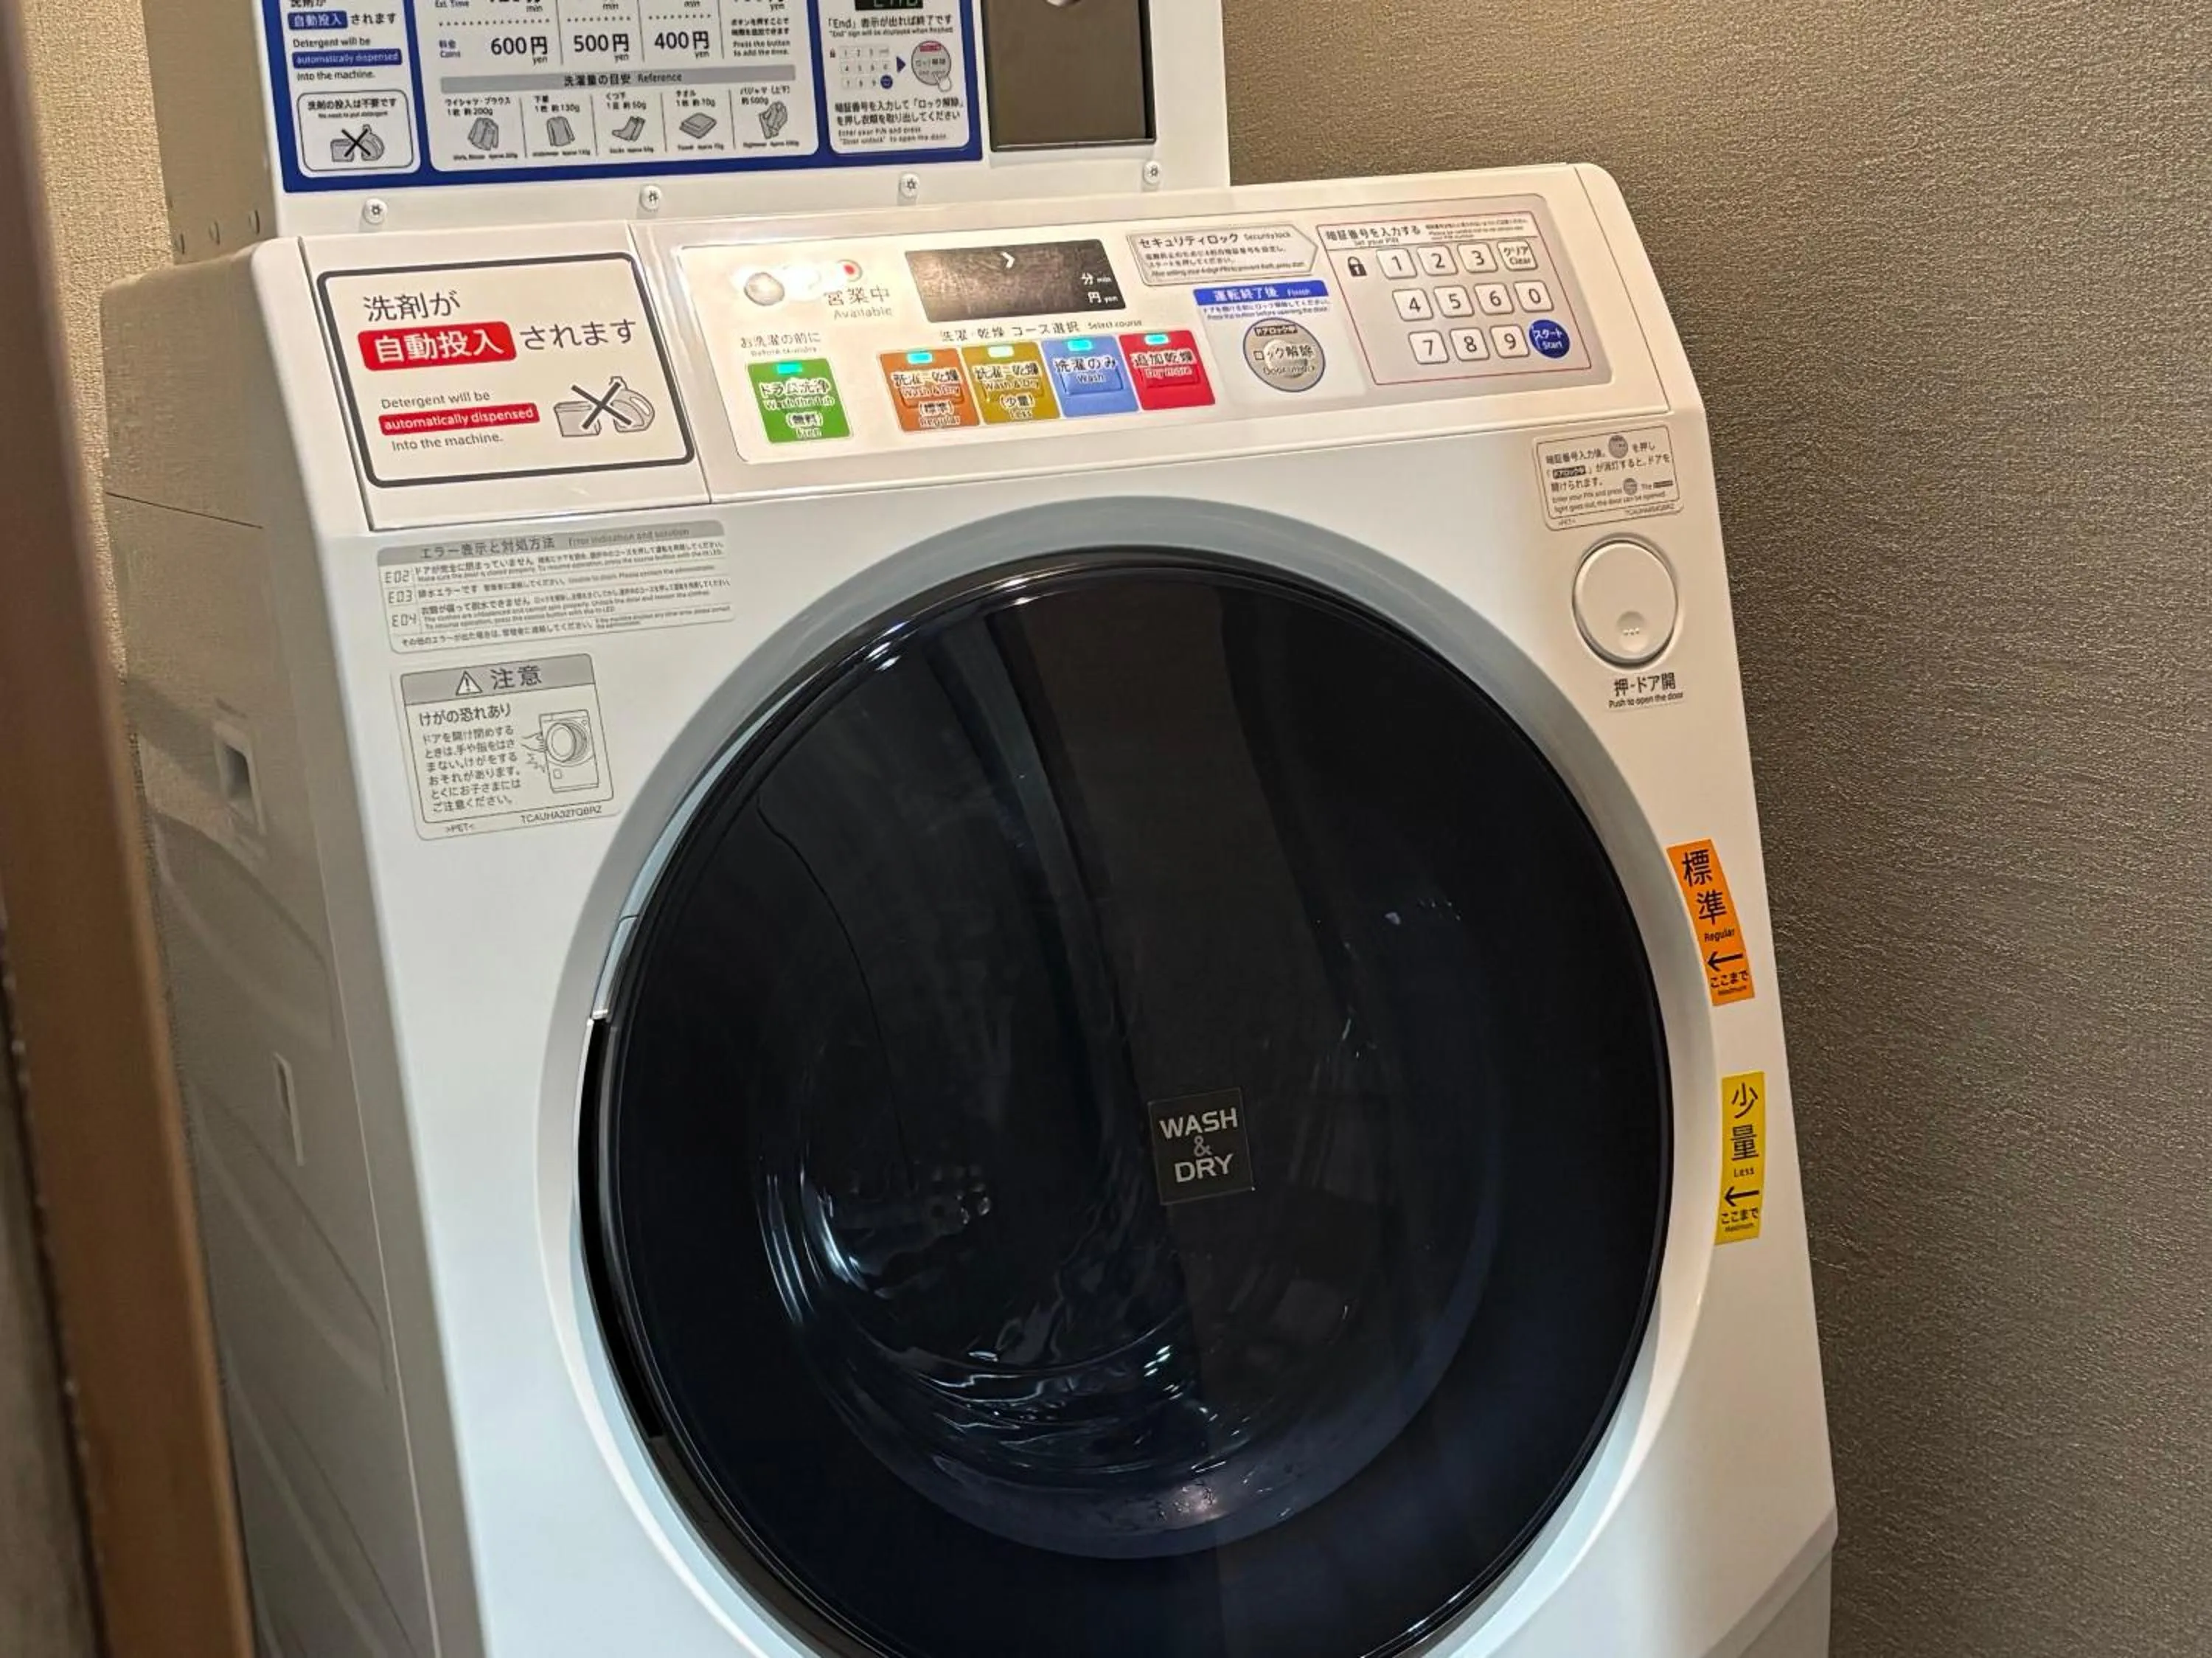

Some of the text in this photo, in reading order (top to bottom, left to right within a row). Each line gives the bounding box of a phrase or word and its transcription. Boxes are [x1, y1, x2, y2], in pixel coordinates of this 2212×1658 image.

[294, 13, 396, 27] 自動投入 されます
[293, 38, 371, 49] Detergent will be
[296, 52, 399, 65] automatically dispensed
[532, 56, 548, 66] yen
[614, 54, 629, 63] yen
[695, 51, 709, 59] yen
[317, 71, 333, 80] the
[637, 73, 682, 83] Reference
[1138, 233, 1239, 249] セキュリティロック
[1326, 224, 1422, 241] 暗証番号を入力する
[1391, 256, 1402, 271] 1
[1431, 253, 1446, 269] 2
[1471, 249, 1485, 266] 3
[1081, 272, 1094, 285] 分
[363, 289, 462, 323] 洗剤が
[1408, 296, 1422, 313] 4
[1448, 293, 1461, 310] 5
[1489, 291, 1502, 308] 6
[833, 307, 893, 320] Available
[1088, 321, 1113, 330] Select
[1534, 327, 1562, 340] スタート
[373, 317, 636, 364] 自動投入 されます
[1422, 339, 1434, 356] 7
[1463, 336, 1477, 353] 8
[1504, 333, 1517, 350] 9
[1541, 339, 1562, 350] Start
[1077, 372, 1104, 384] Wash
[381, 390, 490, 409] Detergent will be
[384, 407, 534, 431] automatically dispensed
[420, 437, 442, 449] the
[444, 432, 504, 446] machine.
[420, 535, 556, 560] エラー表示と対処方法
[384, 569, 410, 585] E02
[388, 589, 414, 605] E03
[391, 612, 417, 628] E04
[491, 665, 542, 690] 注意
[1608, 699, 1627, 709] Push
[1635, 696, 1654, 706] open
[1655, 693, 1666, 702] the
[419, 702, 512, 727] けがの恐れあり
[422, 725, 515, 745] ドアを開け閉めする
[431, 778, 521, 800] とくにお子さまには
[1682, 849, 1727, 926] 標準
[1704, 927, 1735, 943] Regular
[1710, 969, 1748, 988] ここまで
[1158, 1107, 1238, 1140] WASH
[1731, 1082, 1759, 1162] 少量
[1194, 1135, 1214, 1157] &
[1174, 1154, 1234, 1183] DRY
[1734, 1166, 1755, 1179] Less
[1722, 1207, 1759, 1225] ここまで
